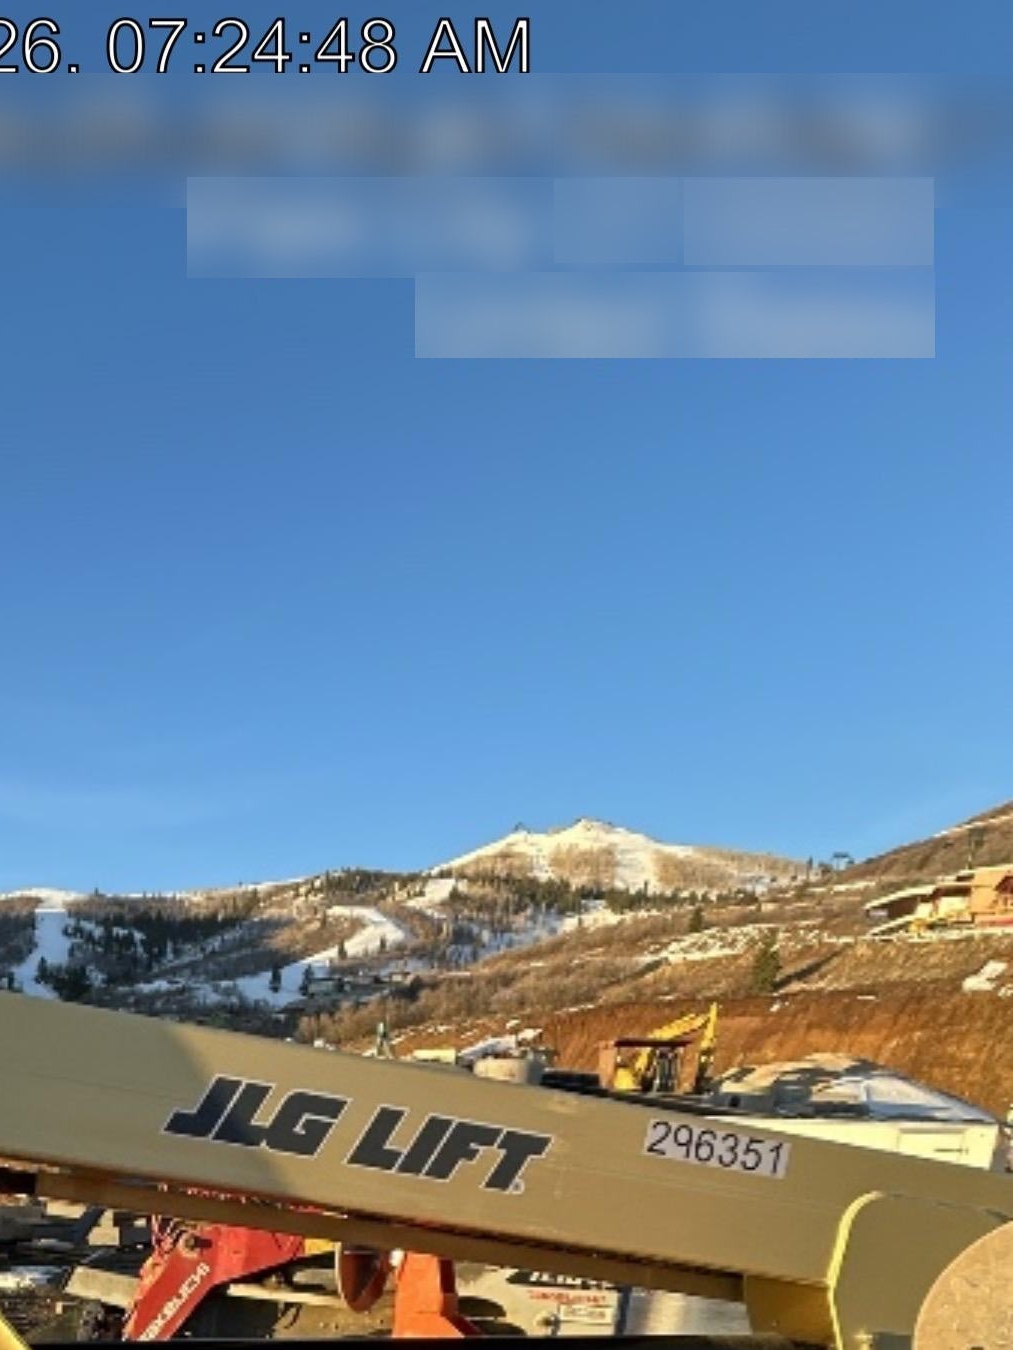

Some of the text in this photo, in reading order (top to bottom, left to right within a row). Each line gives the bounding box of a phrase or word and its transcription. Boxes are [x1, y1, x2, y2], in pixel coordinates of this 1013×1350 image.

[163, 1075, 553, 1192] JLG LIFT
[646, 1121, 784, 1174] 296351
